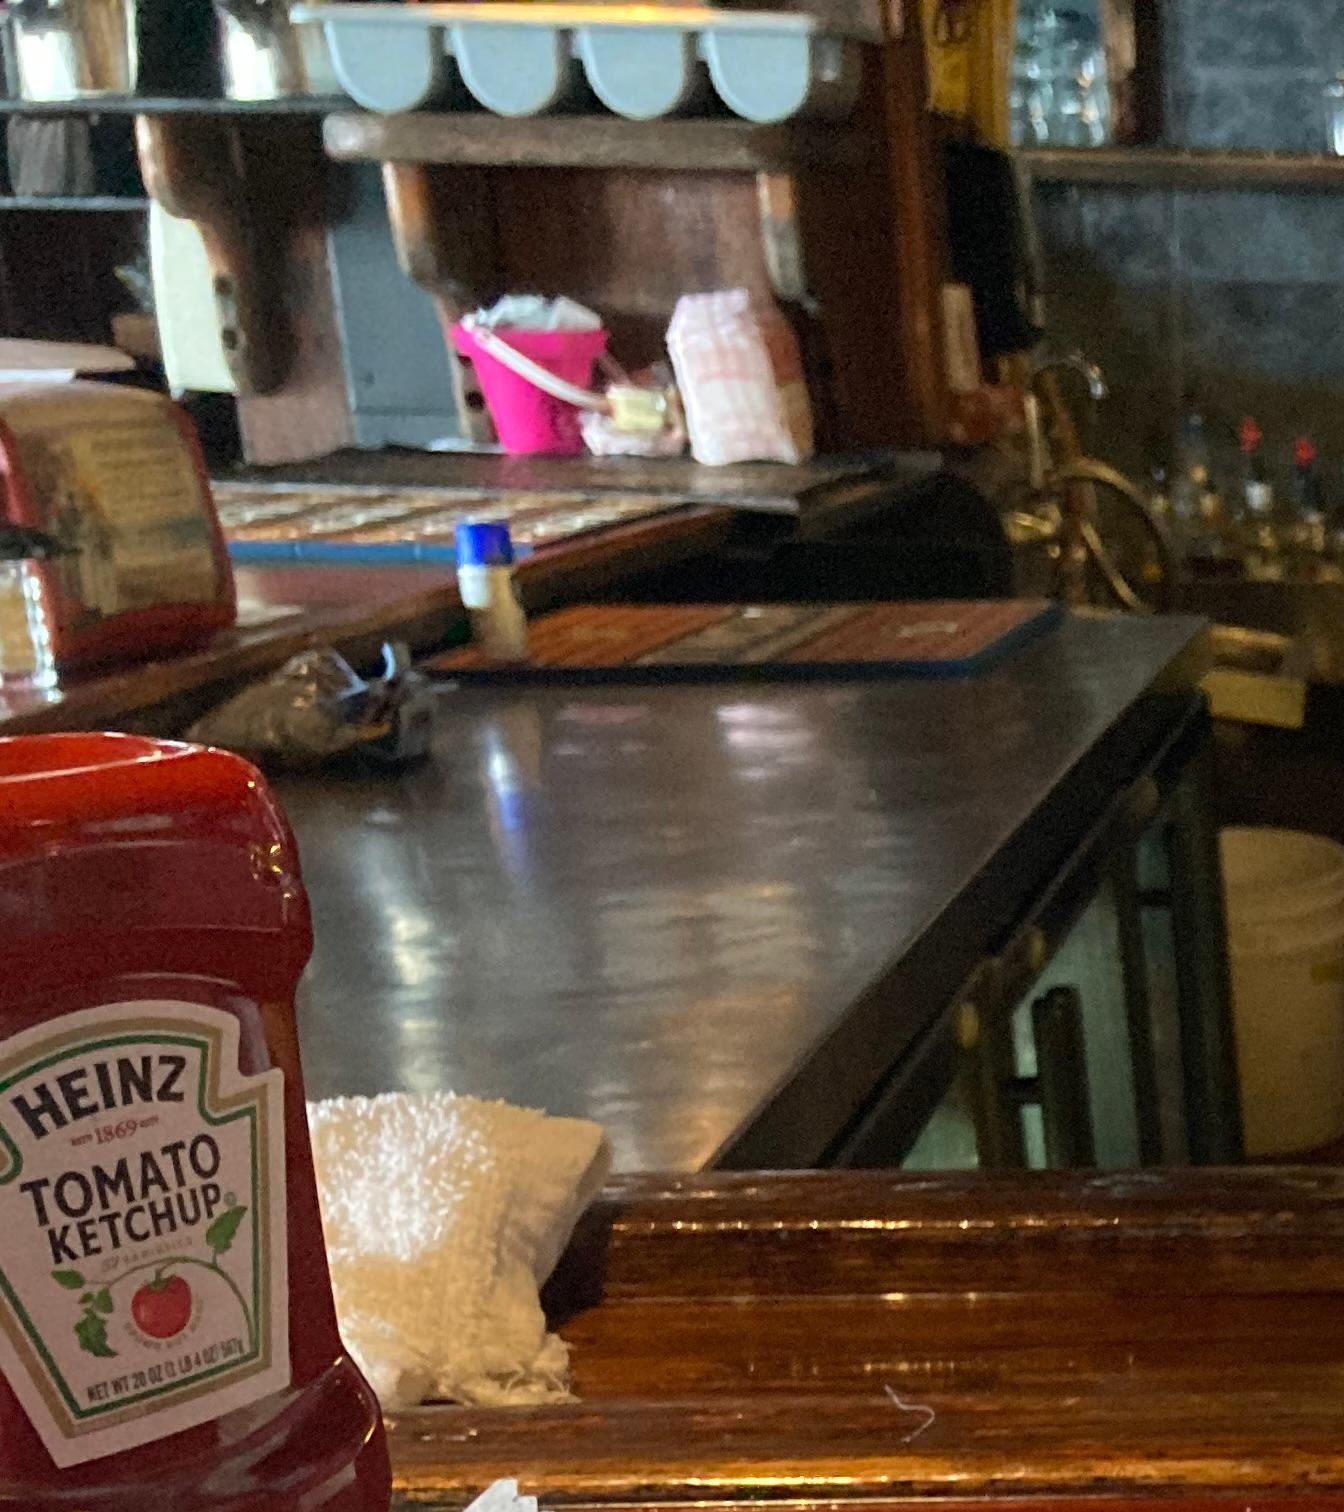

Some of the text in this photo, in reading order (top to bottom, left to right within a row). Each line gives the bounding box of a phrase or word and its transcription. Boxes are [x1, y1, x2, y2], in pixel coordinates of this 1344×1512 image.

[9, 1055, 186, 1140] HEINZ
[94, 1119, 137, 1145] 1869
[20, 1133, 221, 1227] TOMATO
[48, 1183, 221, 1265] KETCHUP
[86, 1381, 110, 1403] NET
[111, 1375, 129, 1396] WT
[132, 1370, 147, 1390] 20
[148, 1364, 163, 1384] OZ
[178, 1354, 193, 1375] LB
